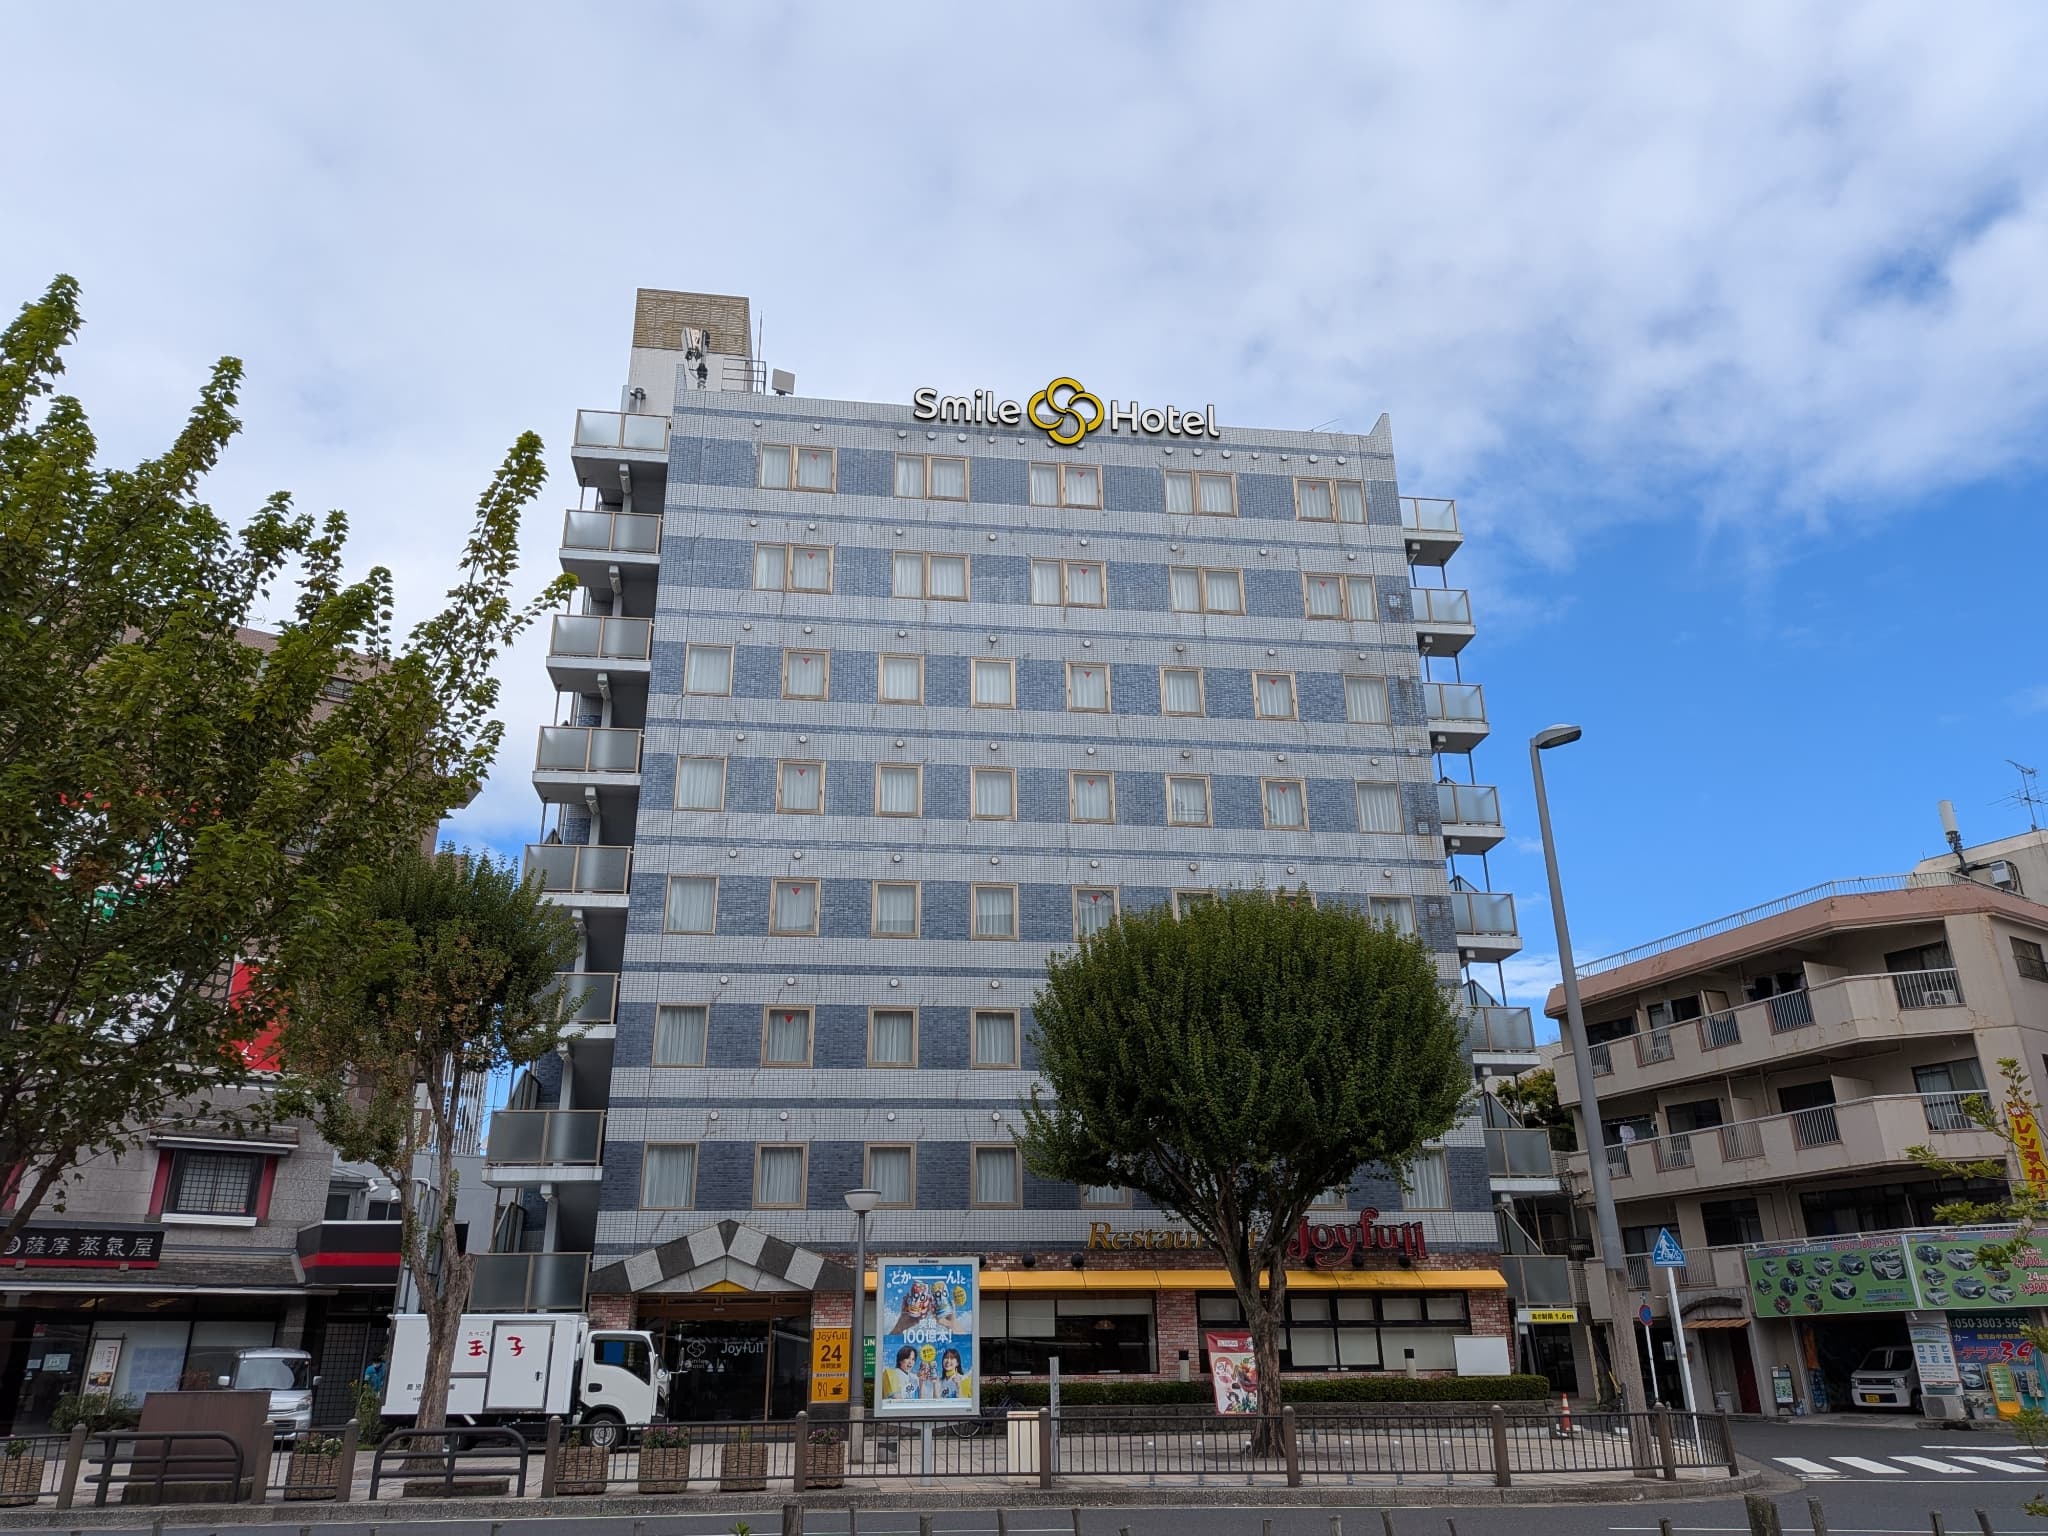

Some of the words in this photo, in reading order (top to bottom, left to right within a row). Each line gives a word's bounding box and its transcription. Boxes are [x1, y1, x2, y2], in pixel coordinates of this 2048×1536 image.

[913, 387, 1022, 425] Smile
[1110, 400, 1220, 438] Hotel
[1087, 1221, 1258, 1250] Restaurt
[1286, 1207, 1429, 1267] Joyfull
[816, 1330, 848, 1342] Joyfull
[720, 1341, 765, 1356] Joyfull
[820, 1344, 842, 1361] 24
